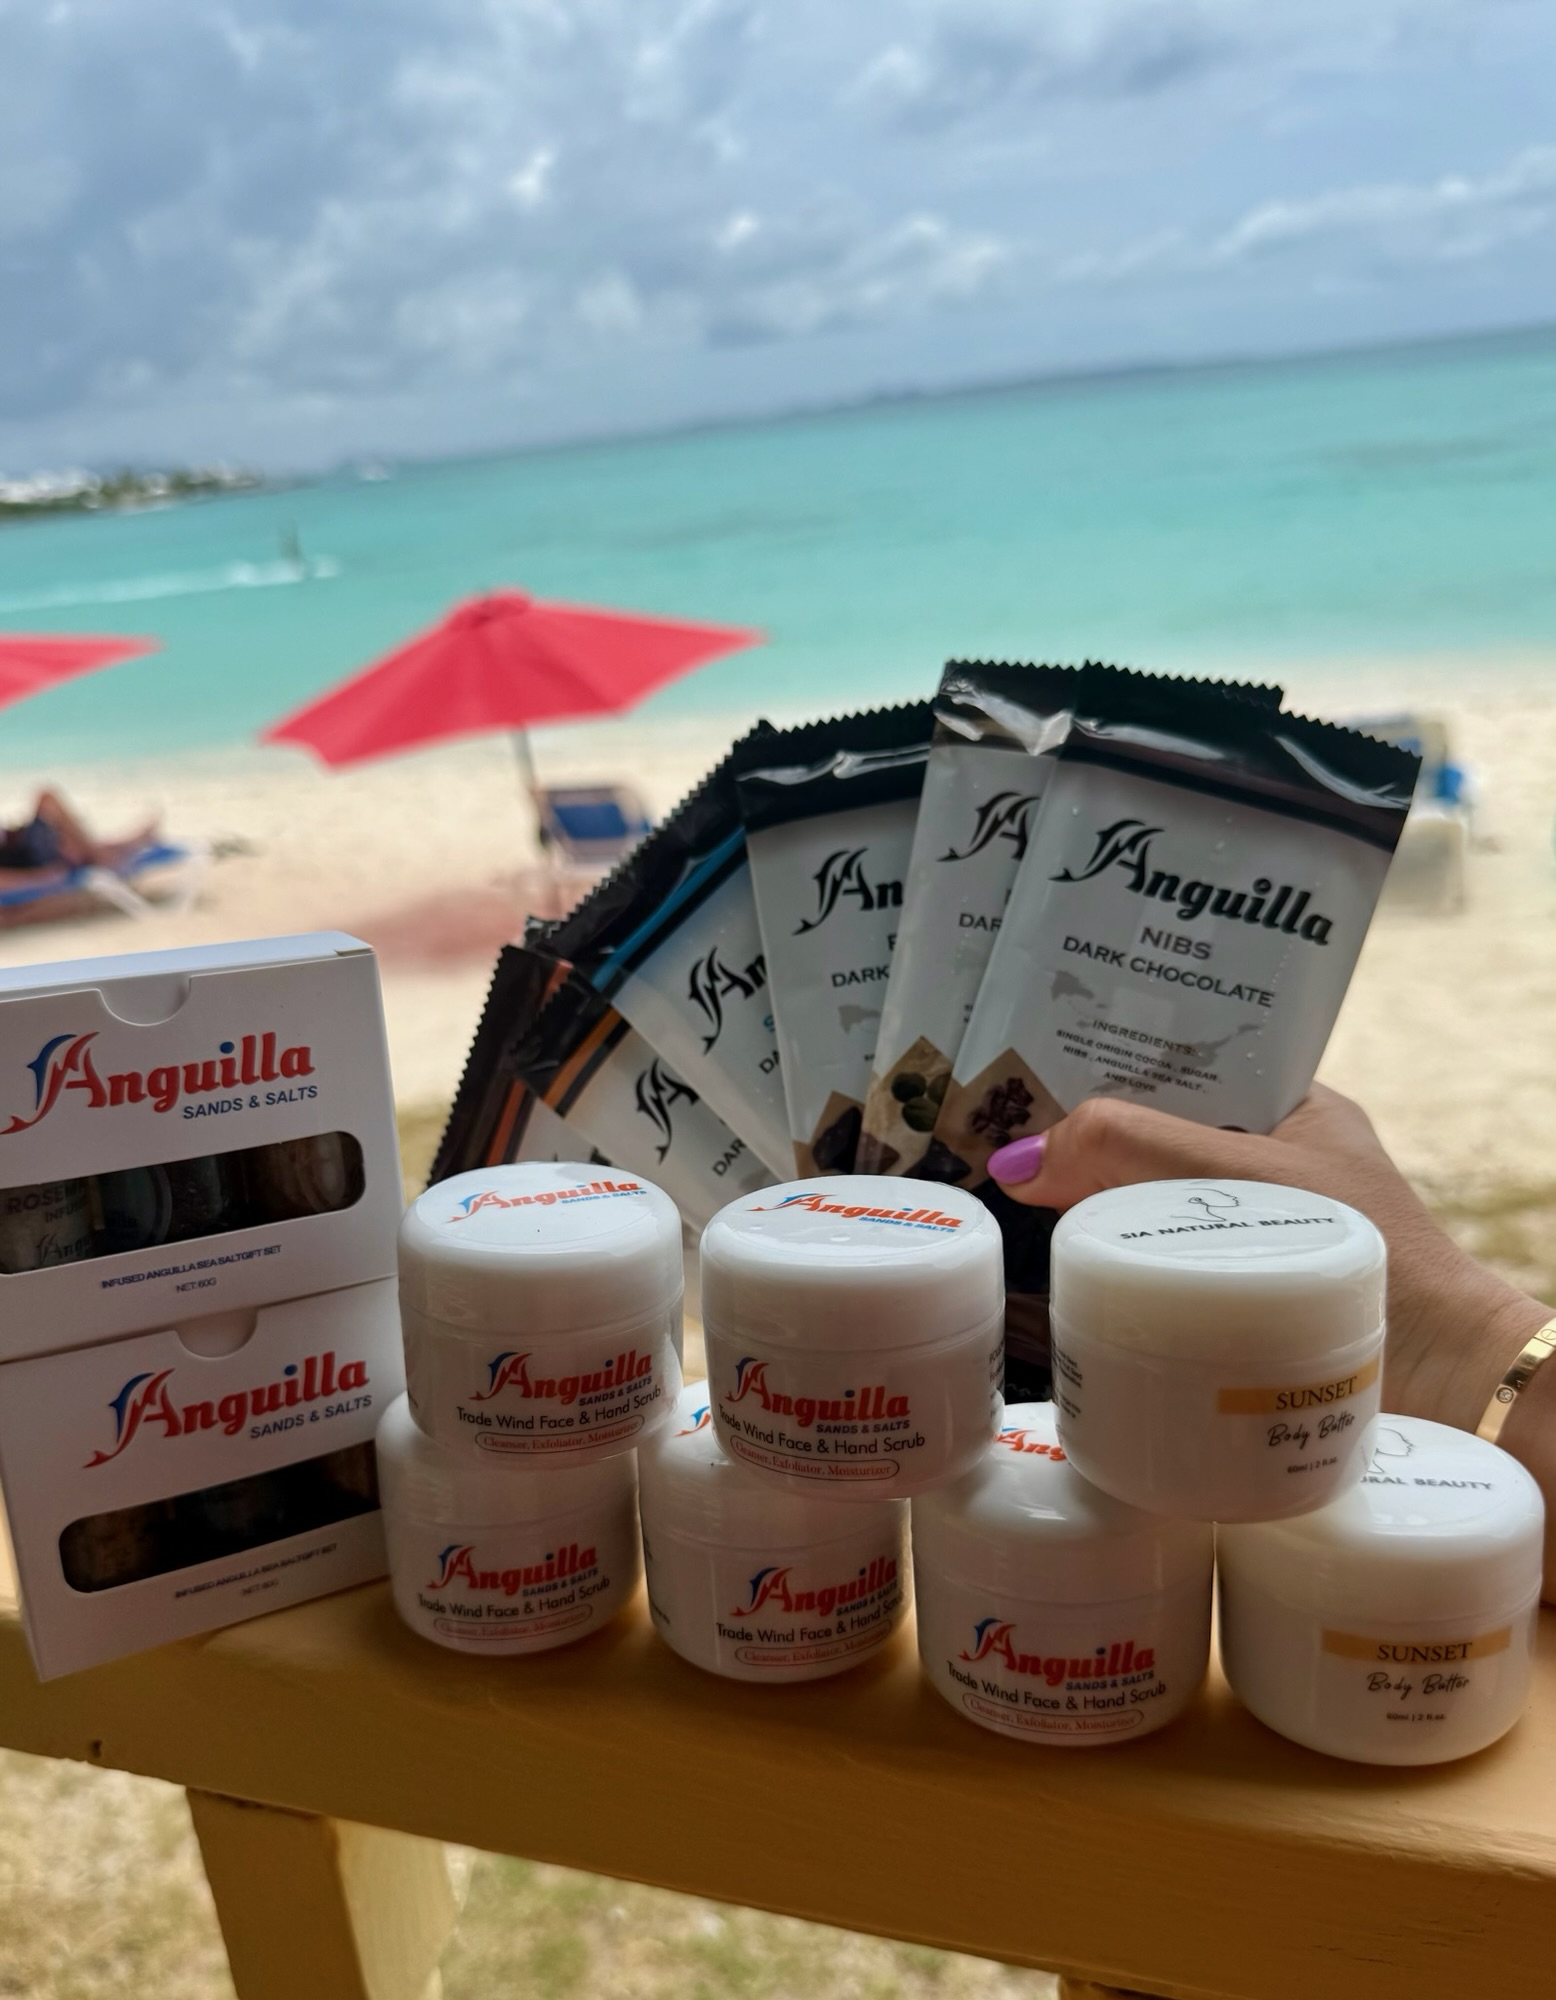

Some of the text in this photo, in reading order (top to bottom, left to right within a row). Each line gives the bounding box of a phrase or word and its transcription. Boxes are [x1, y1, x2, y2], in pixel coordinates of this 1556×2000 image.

[1048, 818, 1335, 946] Anguilla
[1138, 926, 1212, 961] NIBS
[832, 965, 889, 988] DARK
[1062, 935, 1275, 1009] DARK CHOCOLATE
[1056, 1029, 1093, 1047] SINGLE
[1095, 1041, 1133, 1058] ORIGIN
[1092, 1019, 1200, 1057] INGREDIENTS:
[0, 1031, 316, 1135] Anguilla
[1063, 1044, 1088, 1058] NIBS
[1095, 1056, 1148, 1077] ANGUILLA
[1151, 1071, 1173, 1084] SEA
[1103, 1072, 1157, 1092] AND LOVE
[183, 1085, 319, 1120] SANDS & SALTS
[445, 1180, 643, 1223] Anguilla
[562, 1194, 601, 1204] SANDS
[611, 1189, 647, 1199] SALTS
[744, 1192, 963, 1229] Anguilla
[859, 1216, 902, 1227] SANDS
[914, 1223, 956, 1234] SALTS
[1120, 1216, 1335, 1240] SIA NATURAL BEAUTY
[101, 1273, 145, 1289] INFUSED
[146, 1263, 197, 1281] ANGUILLA
[264, 1245, 282, 1256] SET
[469, 1350, 652, 1406] Anguilla
[579, 1375, 653, 1406] SANDS & SALTS
[725, 1357, 911, 1428] Anguilla
[1276, 1375, 1358, 1410] SUNSET
[81, 1351, 370, 1469] Anguilla
[250, 1395, 372, 1440] SANDS & SALTS
[456, 1384, 661, 1430] Trade Wind Face & Hand Scrub
[718, 1403, 741, 1431] Trade
[743, 1420, 774, 1445] Wind
[779, 1433, 812, 1452] Face
[817, 1439, 829, 1454] &
[835, 1440, 878, 1455] Hand
[883, 1432, 926, 1452] Scrub
[816, 1419, 911, 1434] SANDS & SALTS
[1267, 1412, 1356, 1450] Body Butter
[827, 1465, 891, 1476] Moisturizer
[1414, 1478, 1492, 1490] BEAUTY
[426, 1543, 598, 1597] Anguilla
[730, 1556, 897, 1617] Anguilla
[416, 1576, 610, 1618] Trade Wind Face & Hand Scrub
[522, 1583, 558, 1598] SANDS
[716, 1622, 753, 1641] Trade
[757, 1629, 795, 1643] Wind
[800, 1627, 832, 1642] Face
[836, 1620, 847, 1634] &
[850, 1605, 881, 1631] Hand
[958, 1617, 1155, 1687] Anguilla
[1377, 1642, 1473, 1663] SUNSET
[947, 1660, 1166, 1711] Trade Wind Face & Hand Scrub
[1066, 1670, 1154, 1691] SANDS & SALTS
[1367, 1672, 1470, 1700] Body Butter
